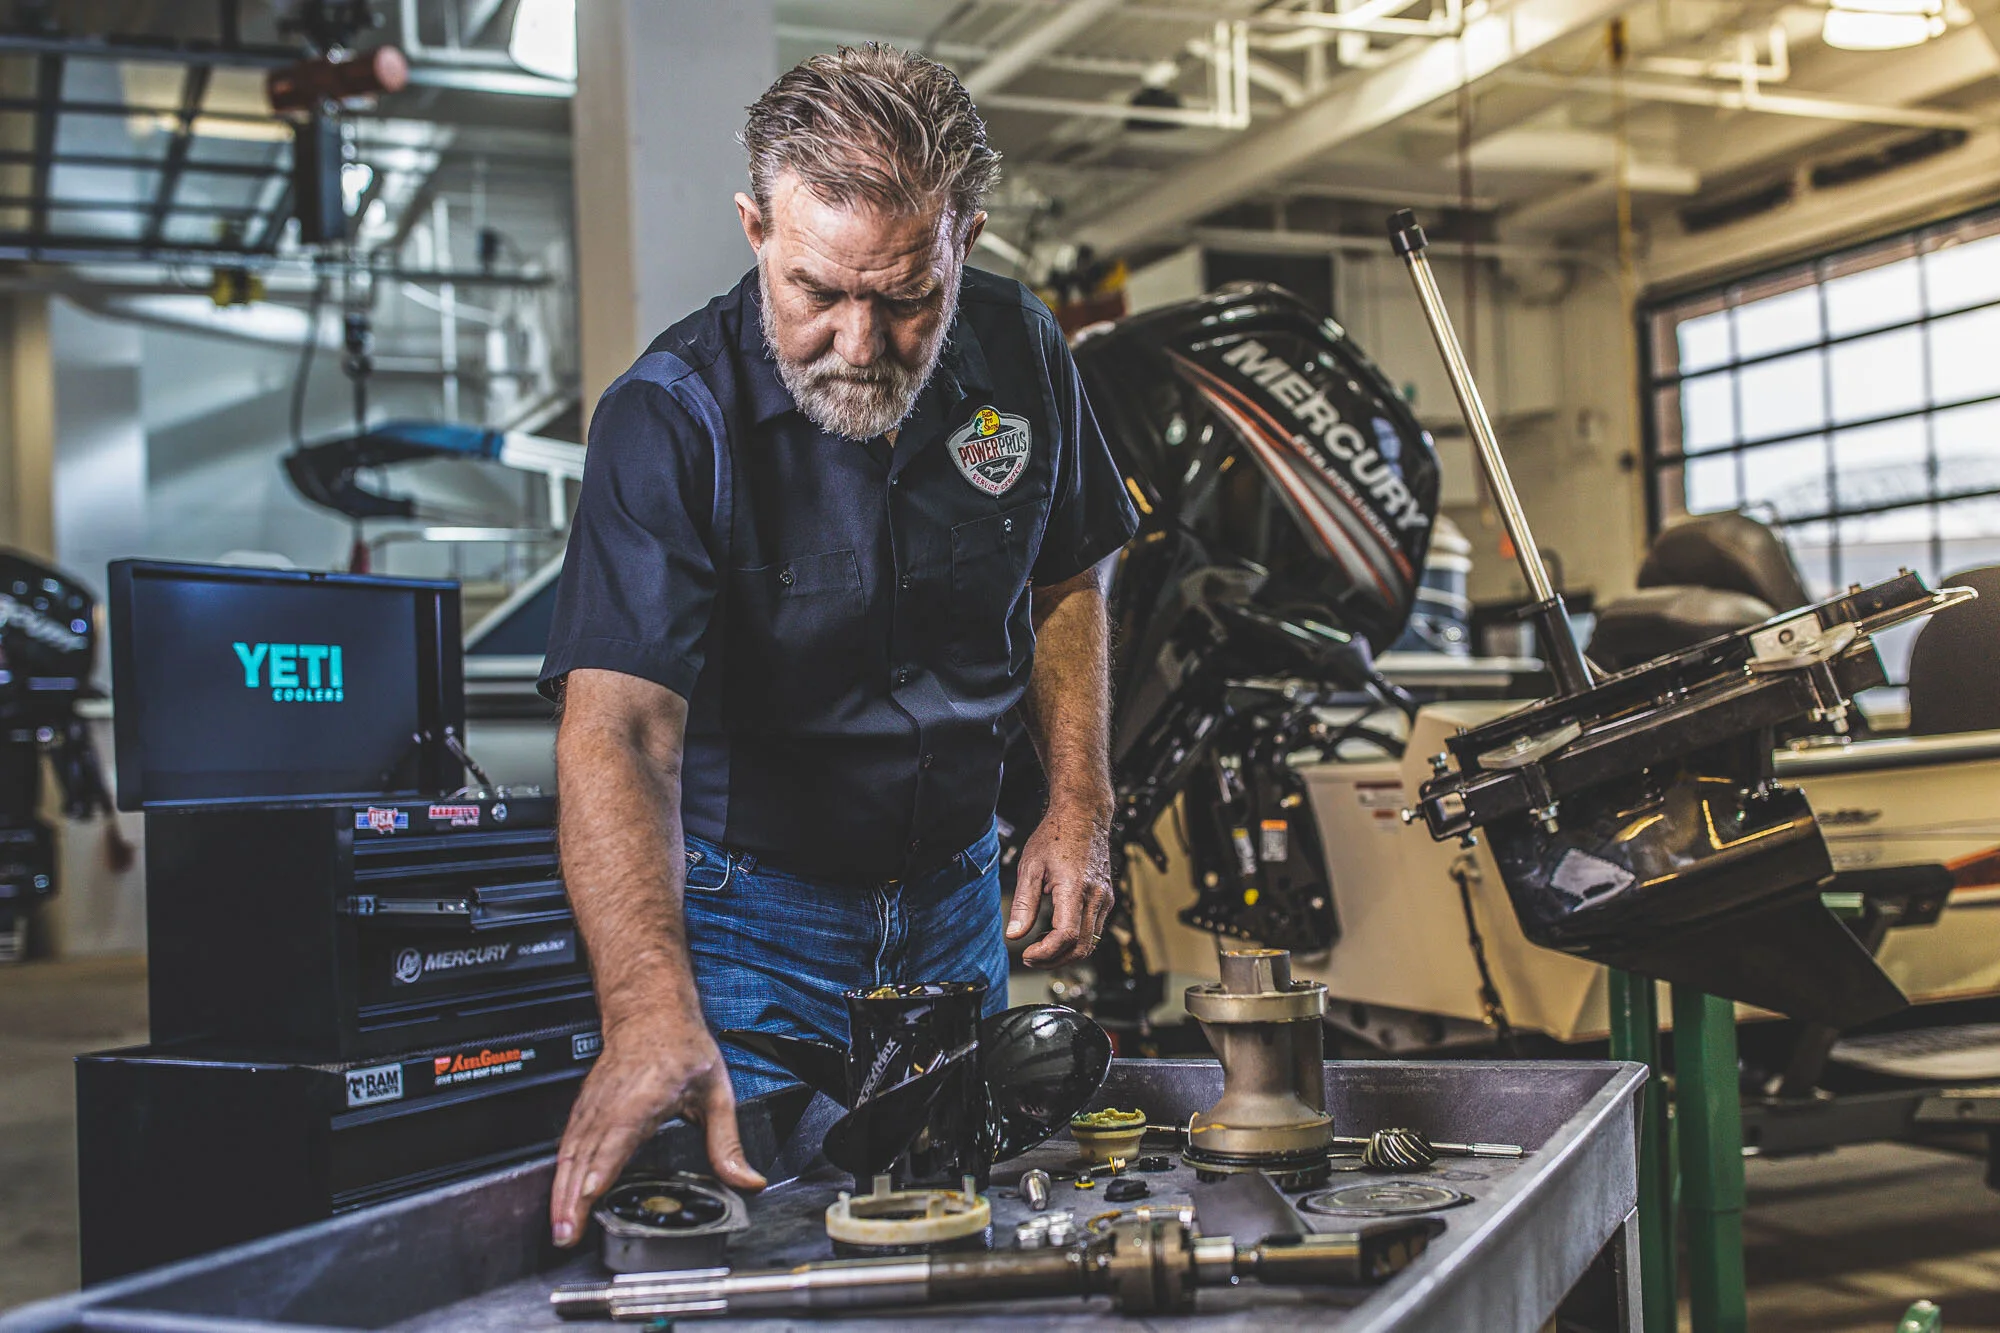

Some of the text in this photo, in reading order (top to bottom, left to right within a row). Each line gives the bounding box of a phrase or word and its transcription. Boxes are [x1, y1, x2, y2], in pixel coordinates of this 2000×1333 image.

[984, 417, 994, 425] Pro
[1221, 339, 1429, 531] MERCURY
[972, 462, 1023, 493] SERVICE CENTER
[232, 641, 343, 688] YETI
[272, 687, 344, 702] COOLERS
[370, 810, 395, 826] USA
[424, 943, 511, 971] MERCURY
[366, 1070, 398, 1089] RAM
